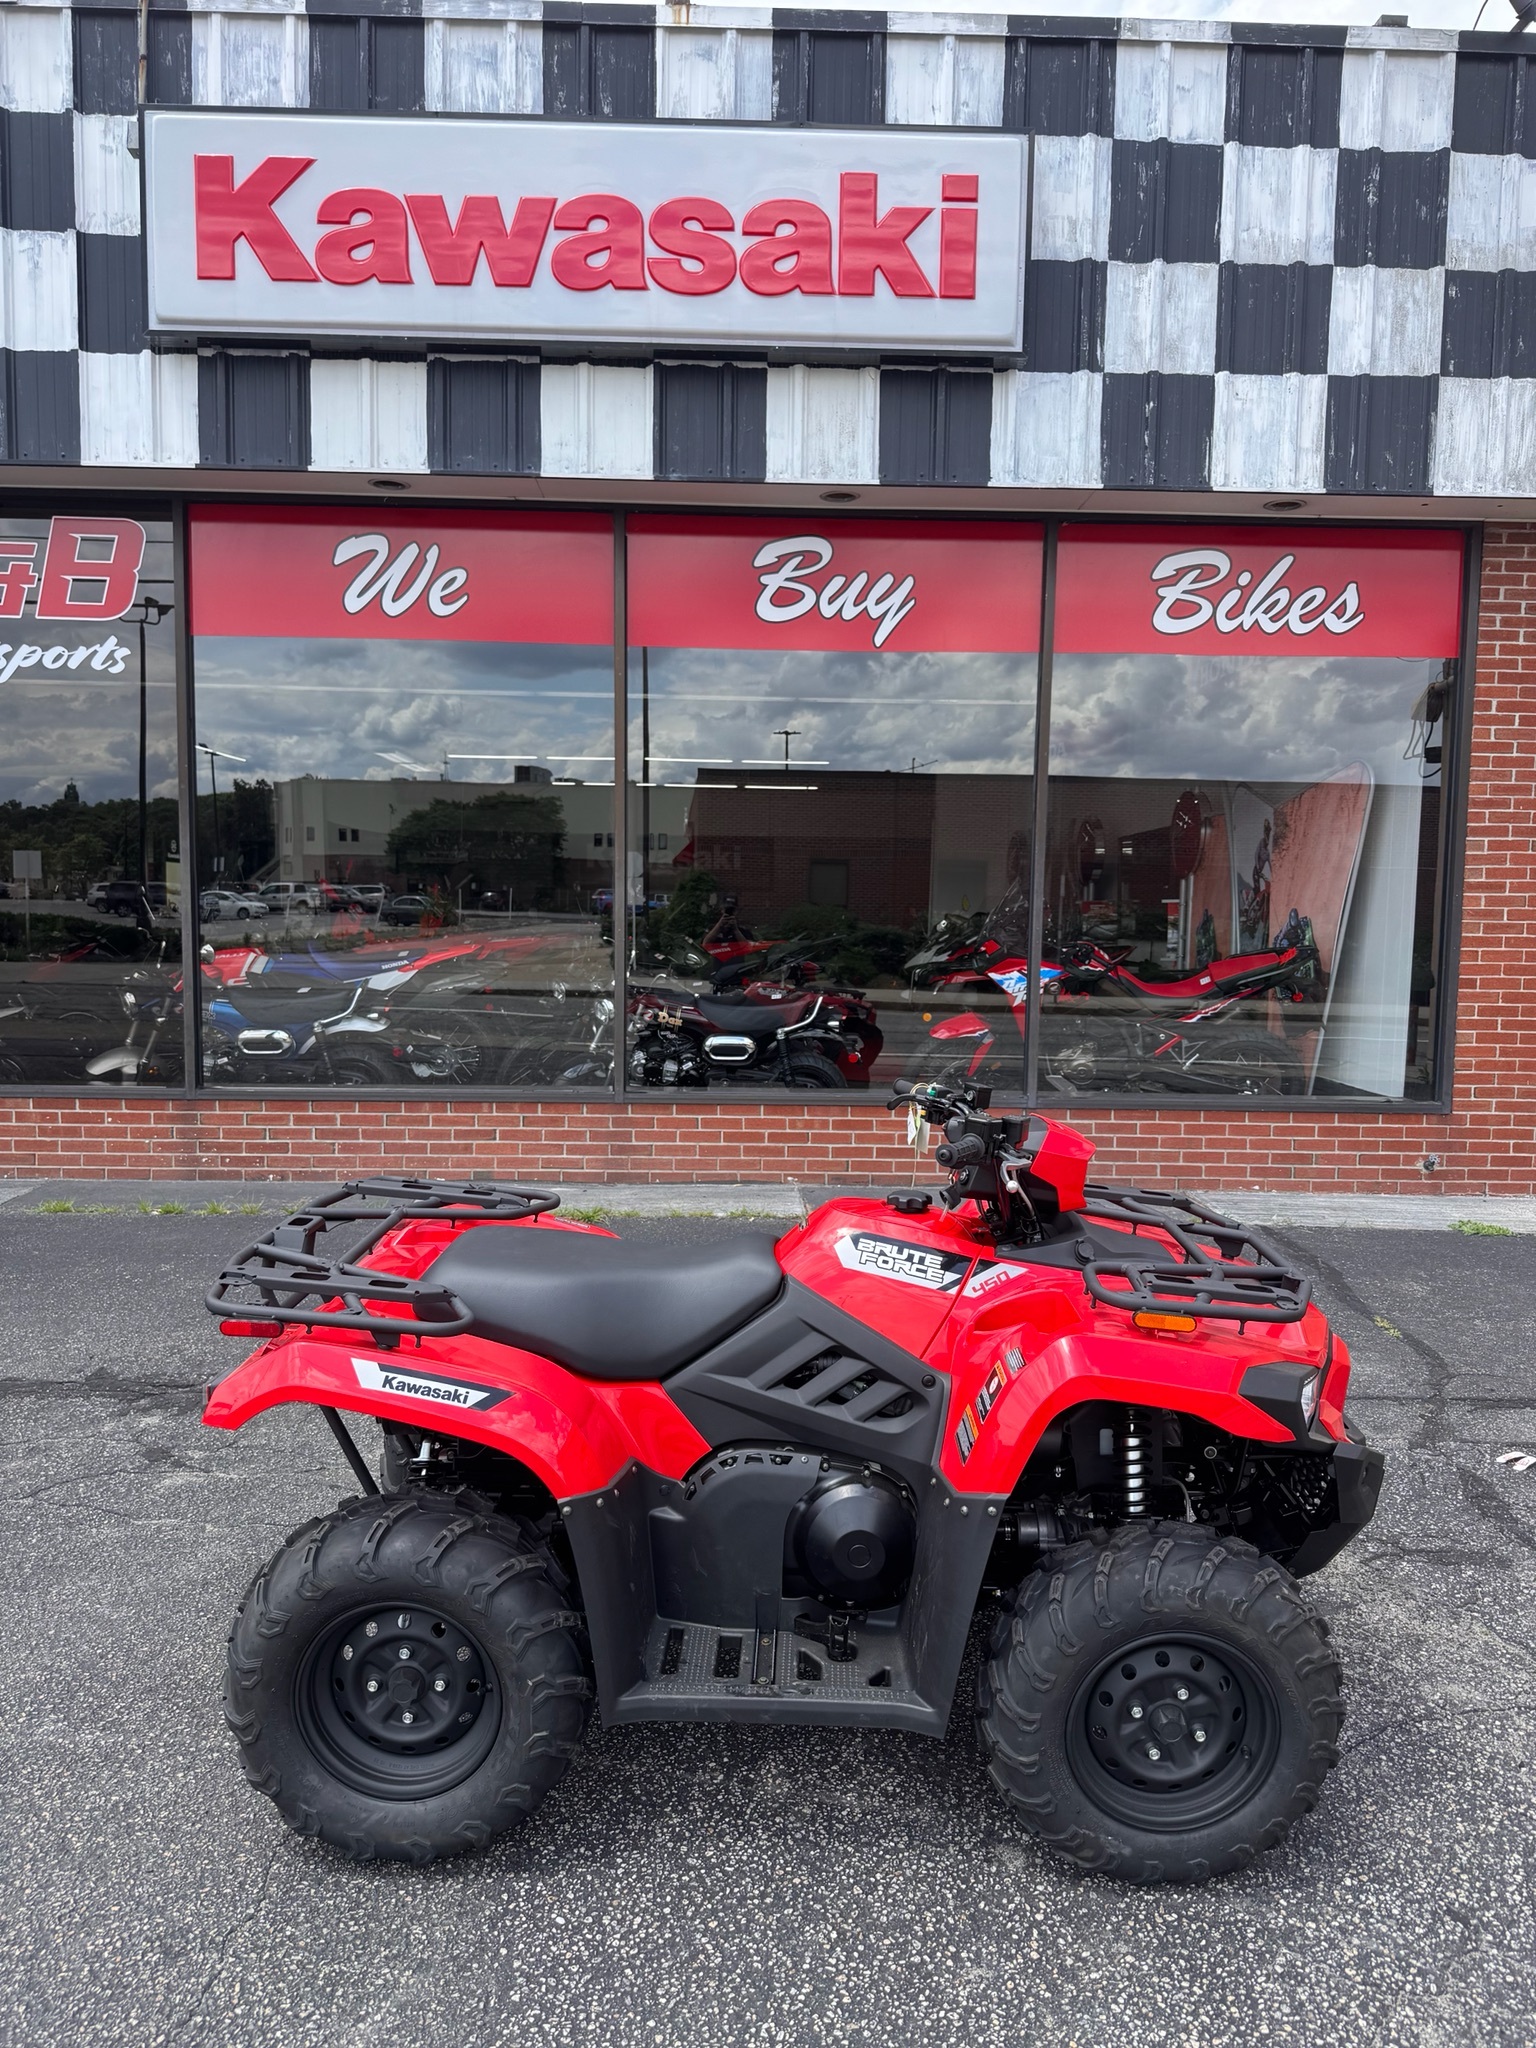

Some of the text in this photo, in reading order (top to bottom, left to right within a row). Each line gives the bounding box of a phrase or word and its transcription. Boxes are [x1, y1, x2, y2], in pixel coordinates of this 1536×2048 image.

[194, 154, 979, 300] Kawasaki
[333, 532, 470, 619] We
[752, 534, 916, 649] Buy
[1151, 548, 1365, 636] Bikes
[381, 960, 410, 970] HONDA
[658, 1011, 683, 1027] Dax
[857, 1238, 943, 1269] BRUTE
[859, 1252, 945, 1284] FORCE
[972, 1271, 1011, 1294] 450
[382, 1374, 470, 1405] Kawasaki
